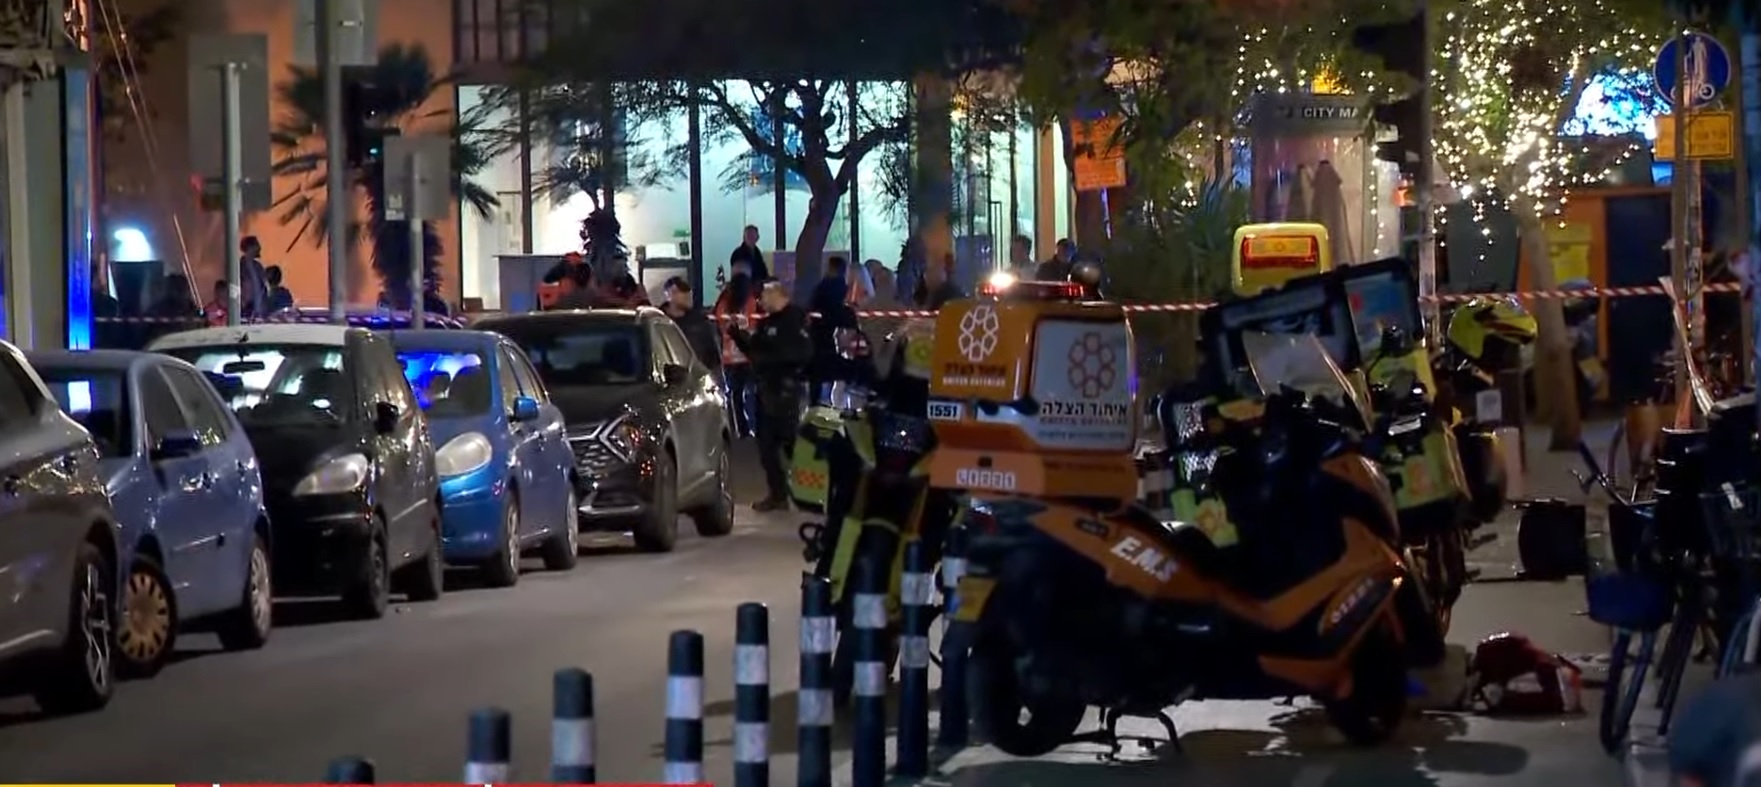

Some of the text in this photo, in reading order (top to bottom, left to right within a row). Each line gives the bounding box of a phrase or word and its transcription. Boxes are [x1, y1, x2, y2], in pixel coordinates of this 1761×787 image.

[1303, 107, 1334, 118] CITY
[1339, 107, 1360, 118] MA
[1042, 400, 1128, 417] איחוד הצלה
